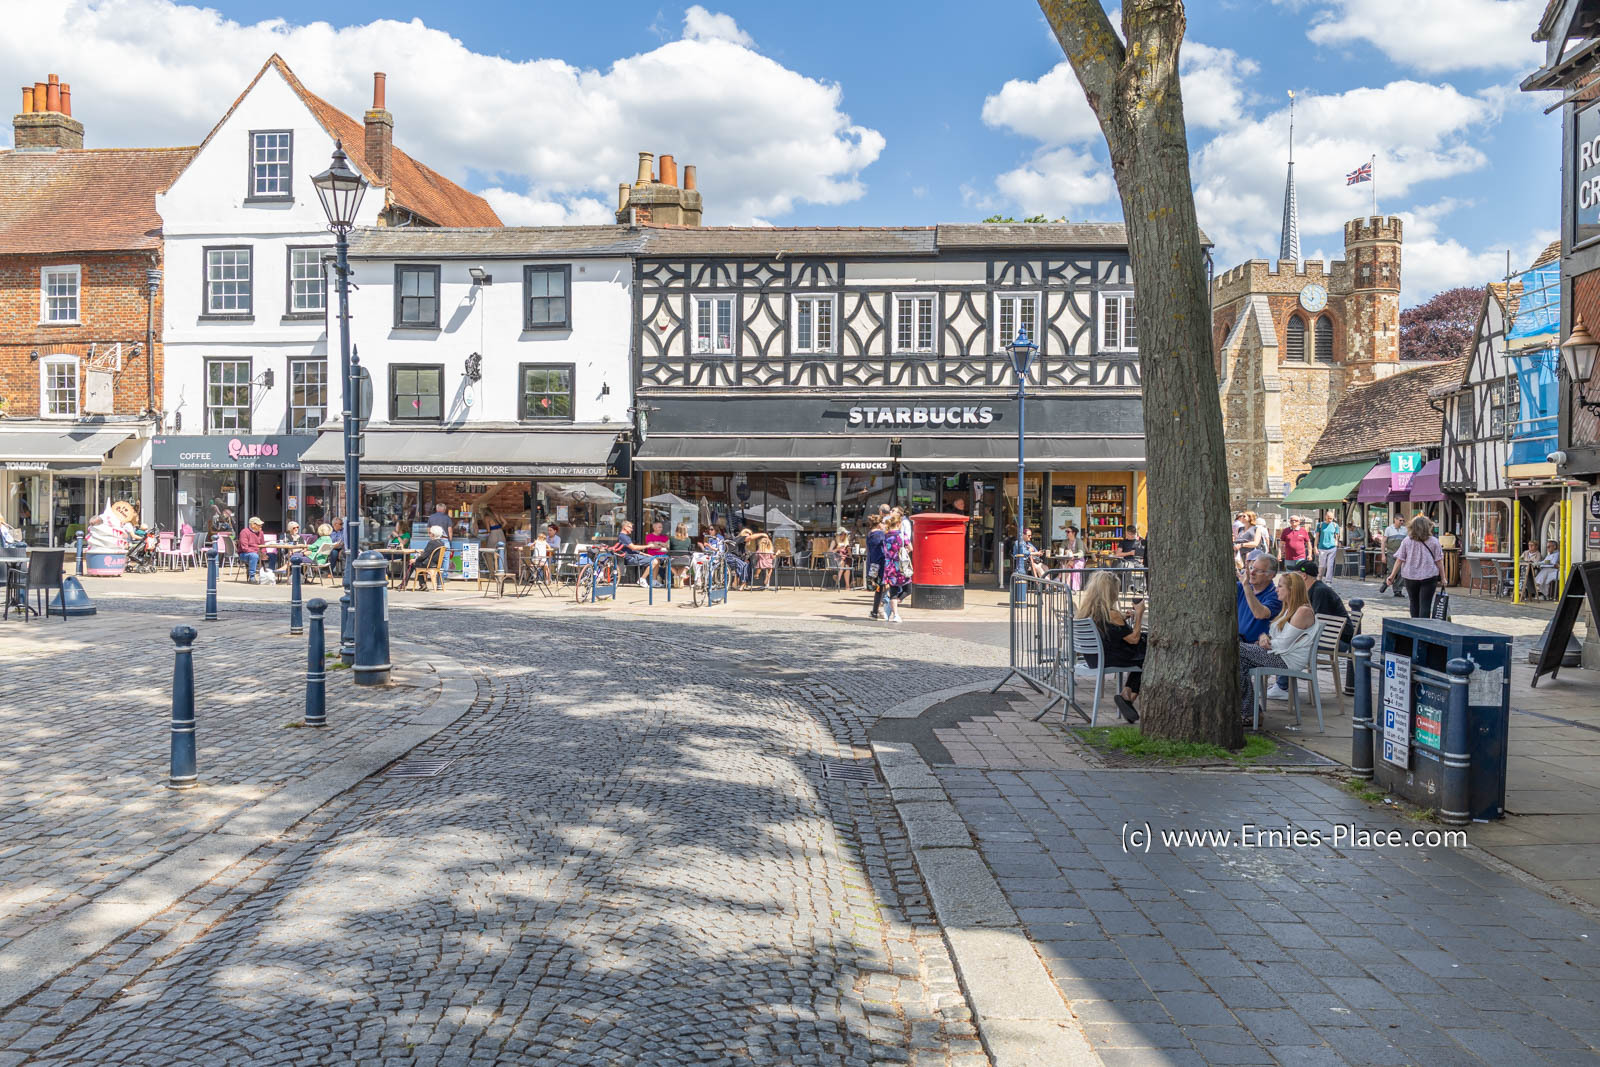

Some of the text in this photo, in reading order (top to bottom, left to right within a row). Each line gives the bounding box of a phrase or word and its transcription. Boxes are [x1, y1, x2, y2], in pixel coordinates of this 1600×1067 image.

[849, 406, 993, 424] STARBUCKS
[179, 452, 212, 460] COFFEE
[397, 465, 509, 474] ARTISAN COFFEE AND MORE
[840, 462, 888, 470] STARBUCKS
